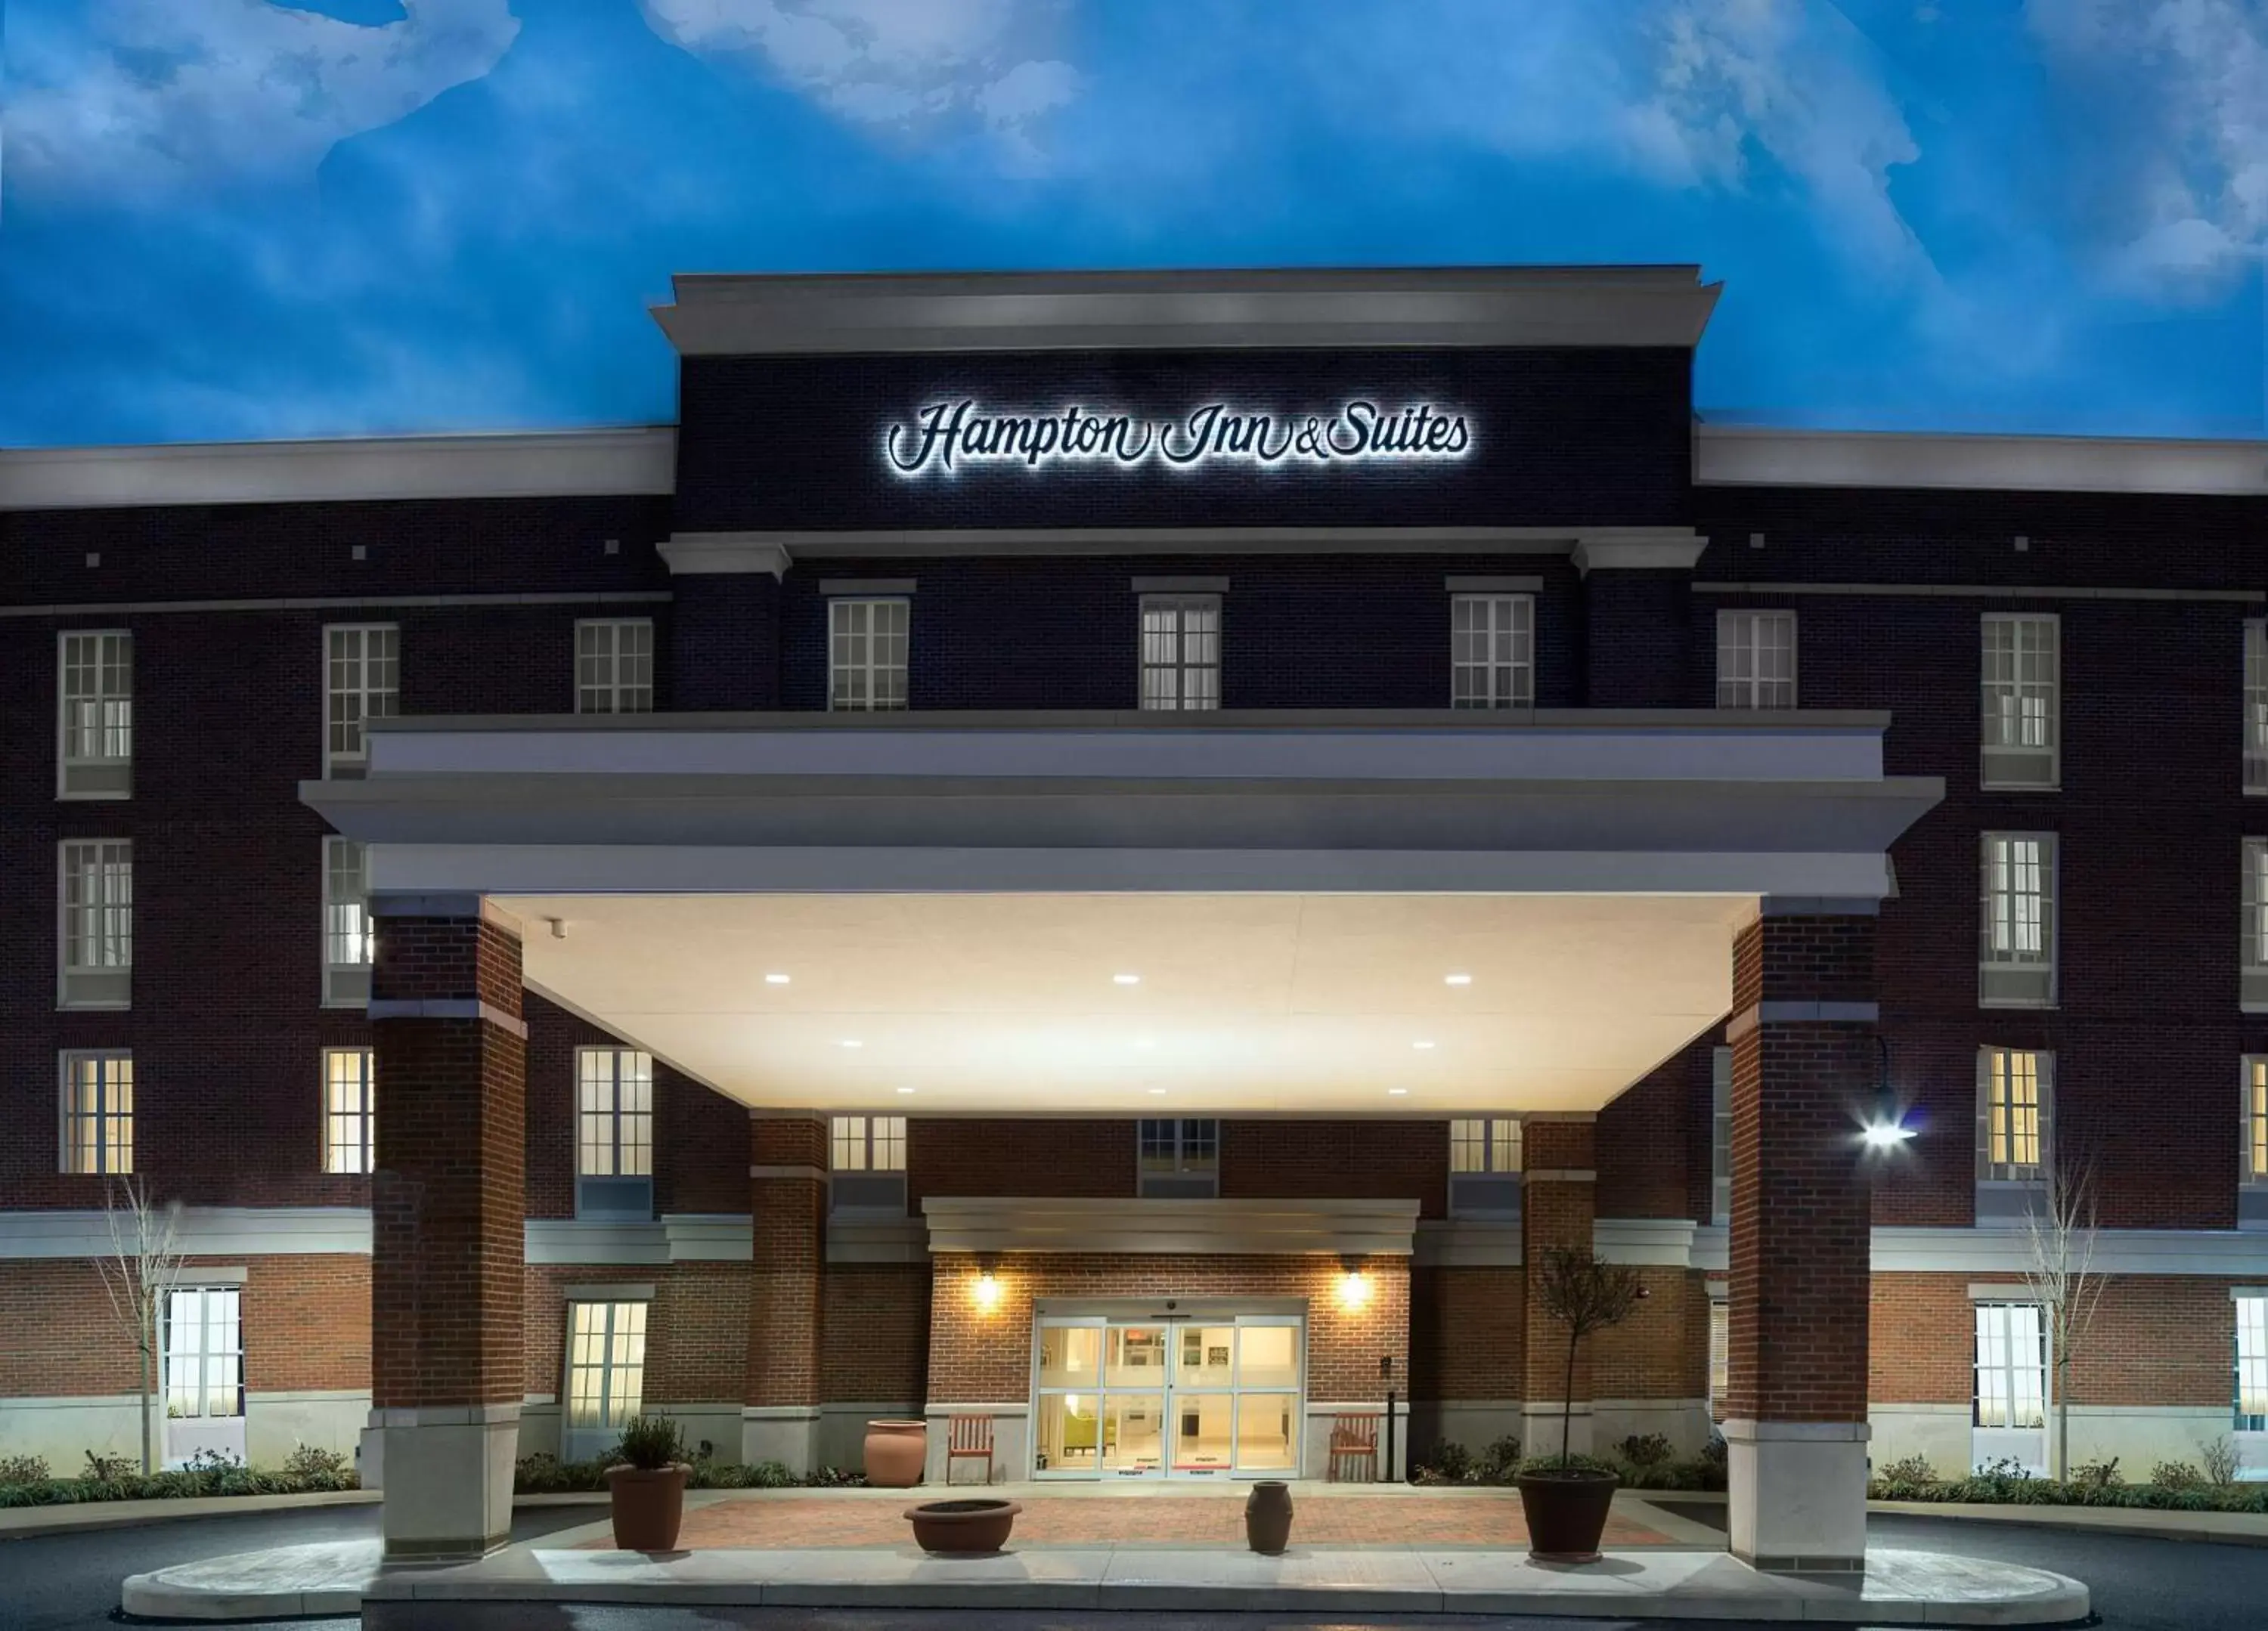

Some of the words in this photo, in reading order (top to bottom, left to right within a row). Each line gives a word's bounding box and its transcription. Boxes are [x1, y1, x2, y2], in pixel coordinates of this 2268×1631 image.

[888, 399, 1152, 471] Hampton
[1160, 404, 1294, 463] Inn
[1295, 416, 1330, 459] &
[1327, 401, 1469, 456] Suites
